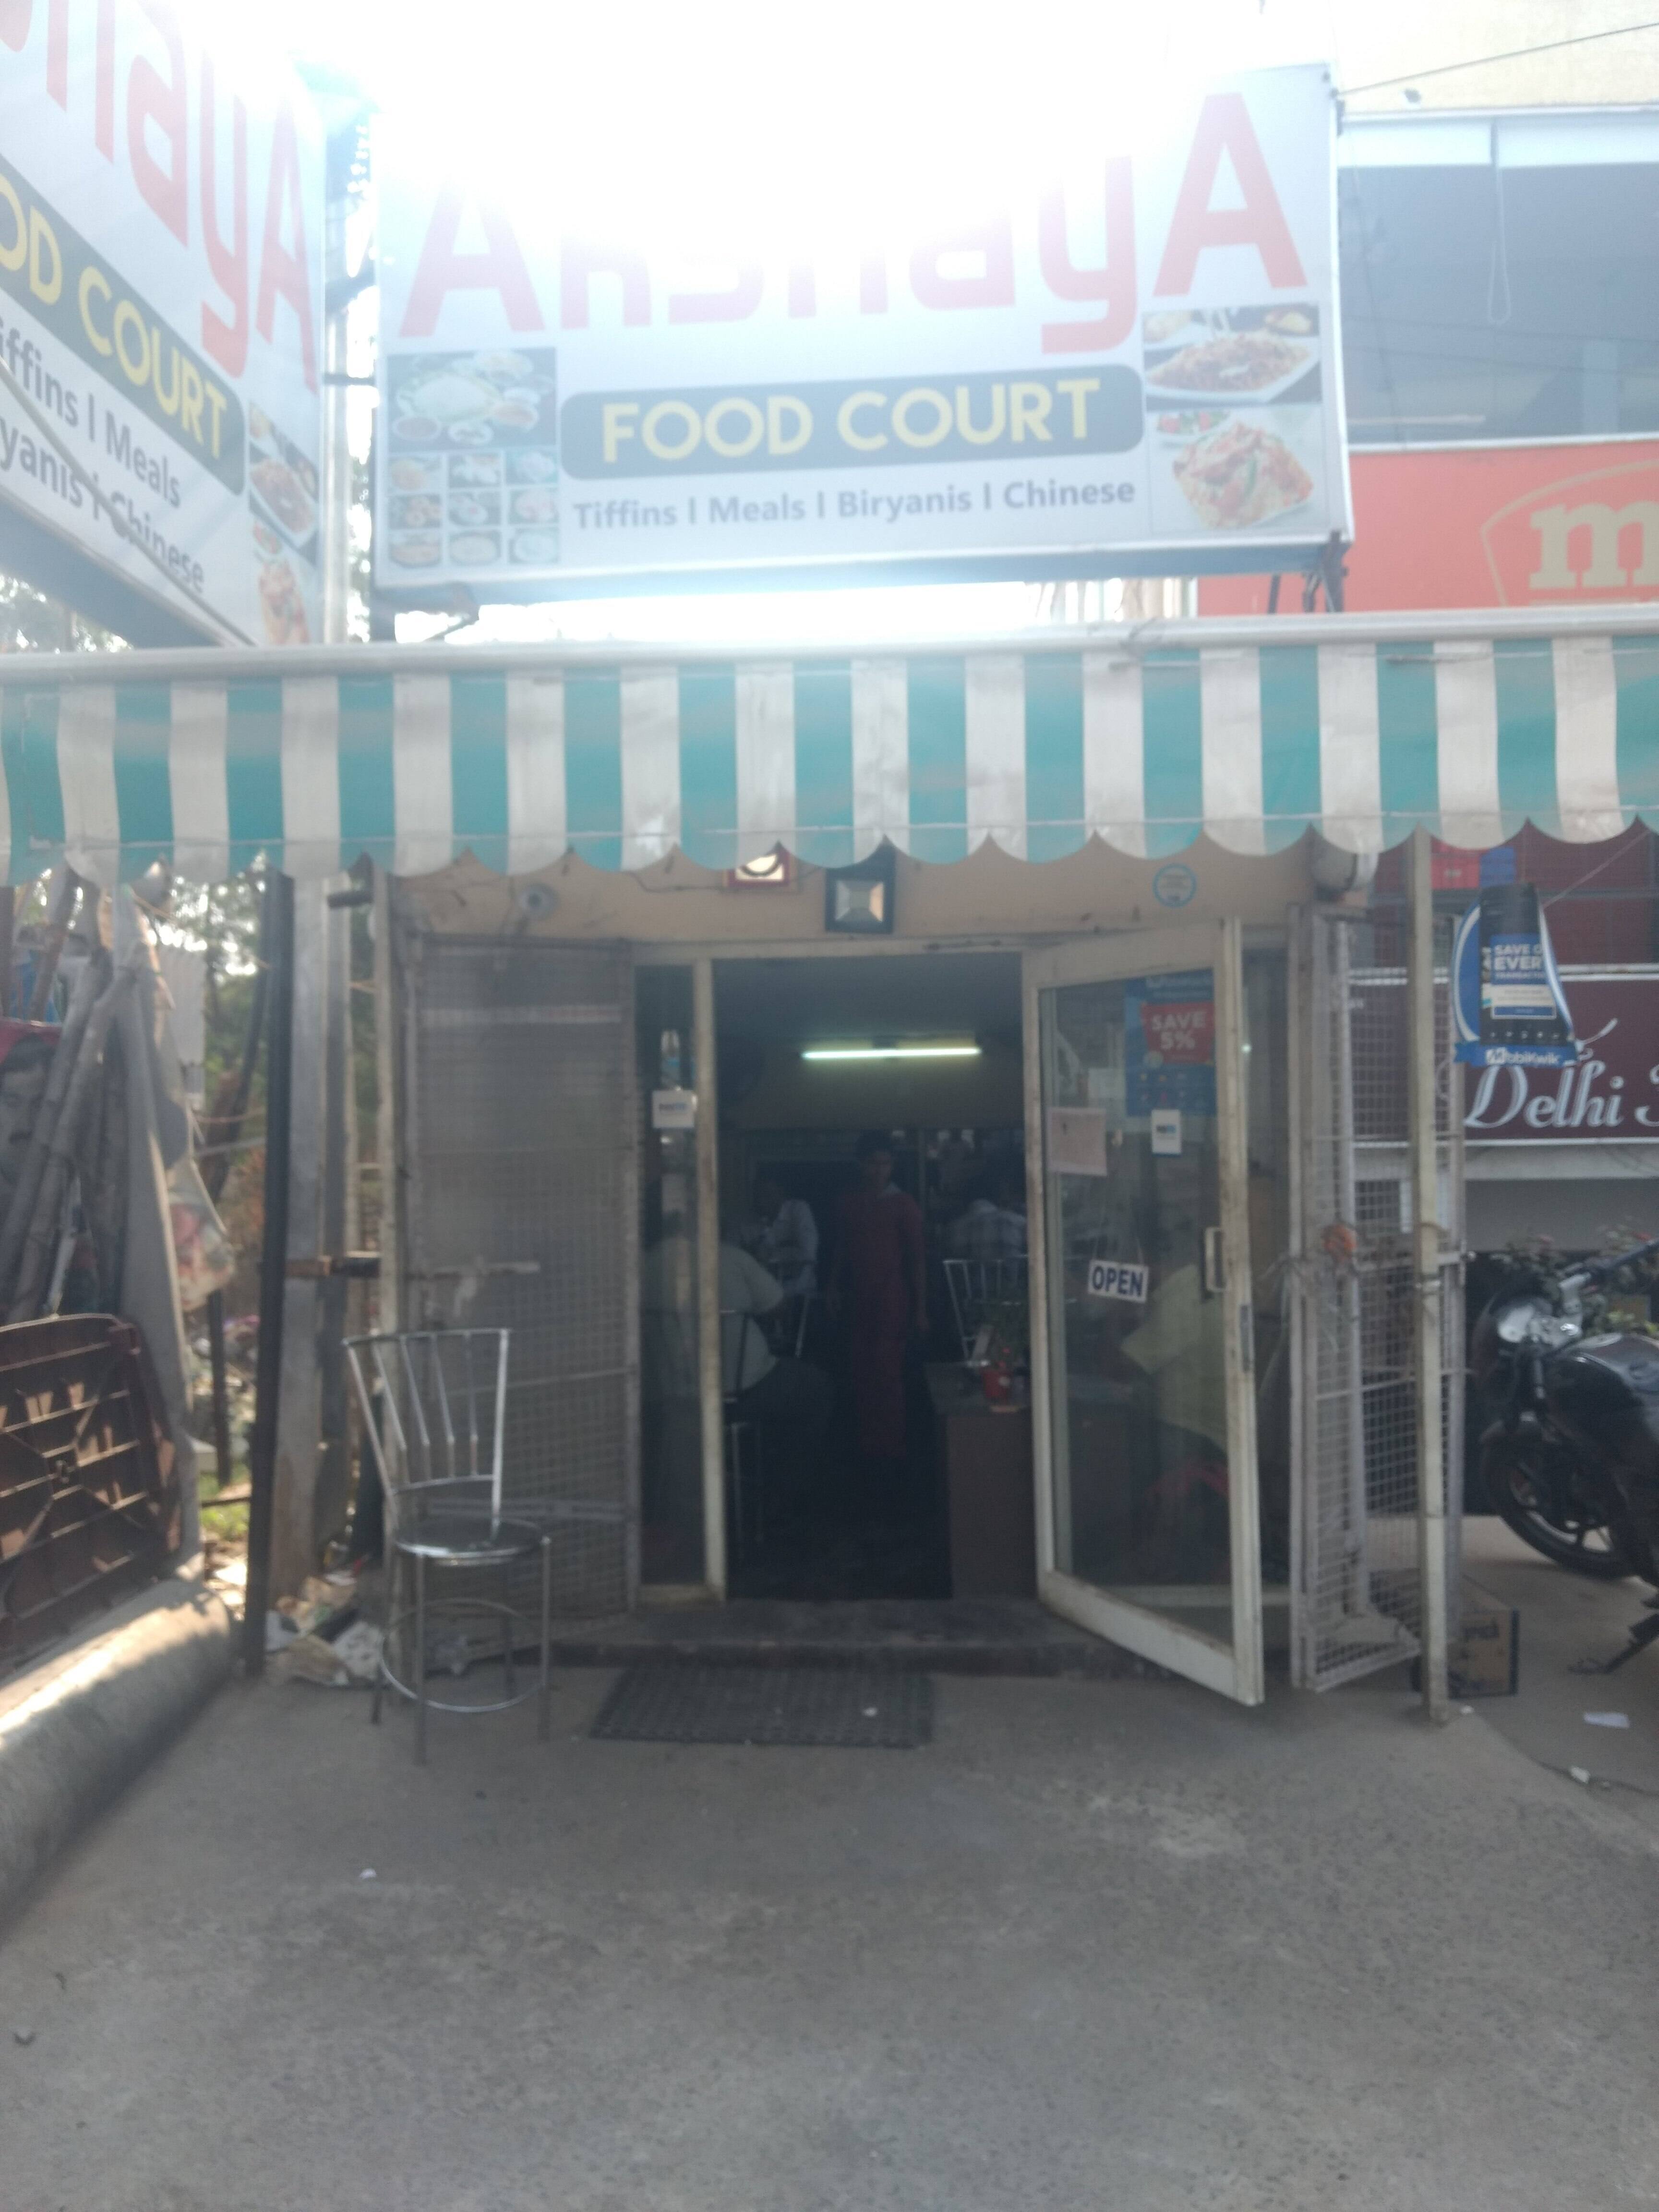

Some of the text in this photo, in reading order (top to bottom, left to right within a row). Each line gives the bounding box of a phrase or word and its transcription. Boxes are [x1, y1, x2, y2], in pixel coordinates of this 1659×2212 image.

[0, 0, 319, 396] ayA
[78, 265, 228, 459] COURT
[106, 410, 180, 509] Meals
[603, 377, 1101, 463] FOOD COURT
[574, 498, 676, 529] Tiffins
[709, 492, 805, 524] Meals
[838, 484, 972, 523] Biryanis
[1003, 478, 1135, 509] Chinese
[1151, 1010, 1207, 1031] SAVE
[1160, 1030, 1196, 1051] 5%
[1461, 1039, 1625, 1128] Delhi
[1091, 1264, 1144, 1298] OPEN
